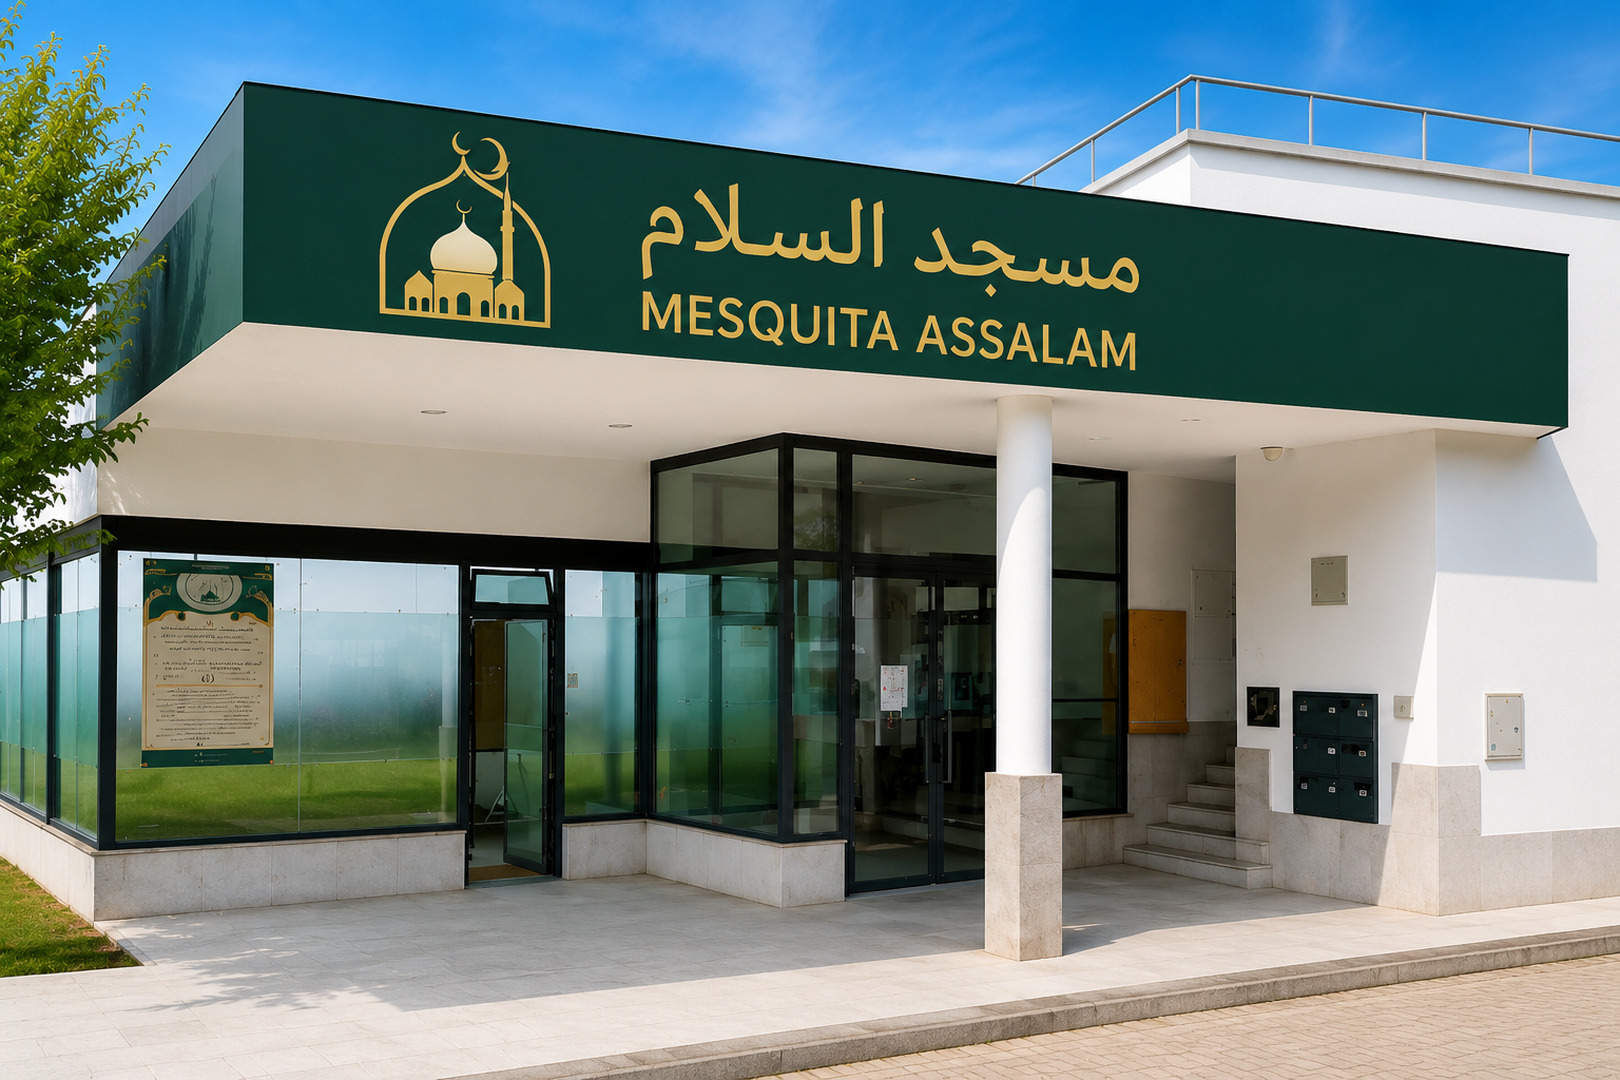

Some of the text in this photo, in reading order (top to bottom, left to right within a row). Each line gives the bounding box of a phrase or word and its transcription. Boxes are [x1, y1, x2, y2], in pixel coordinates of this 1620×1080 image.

[641, 183, 1140, 298] مسجد السلام
[641, 290, 1136, 371] MESQUITA ASSALAM
